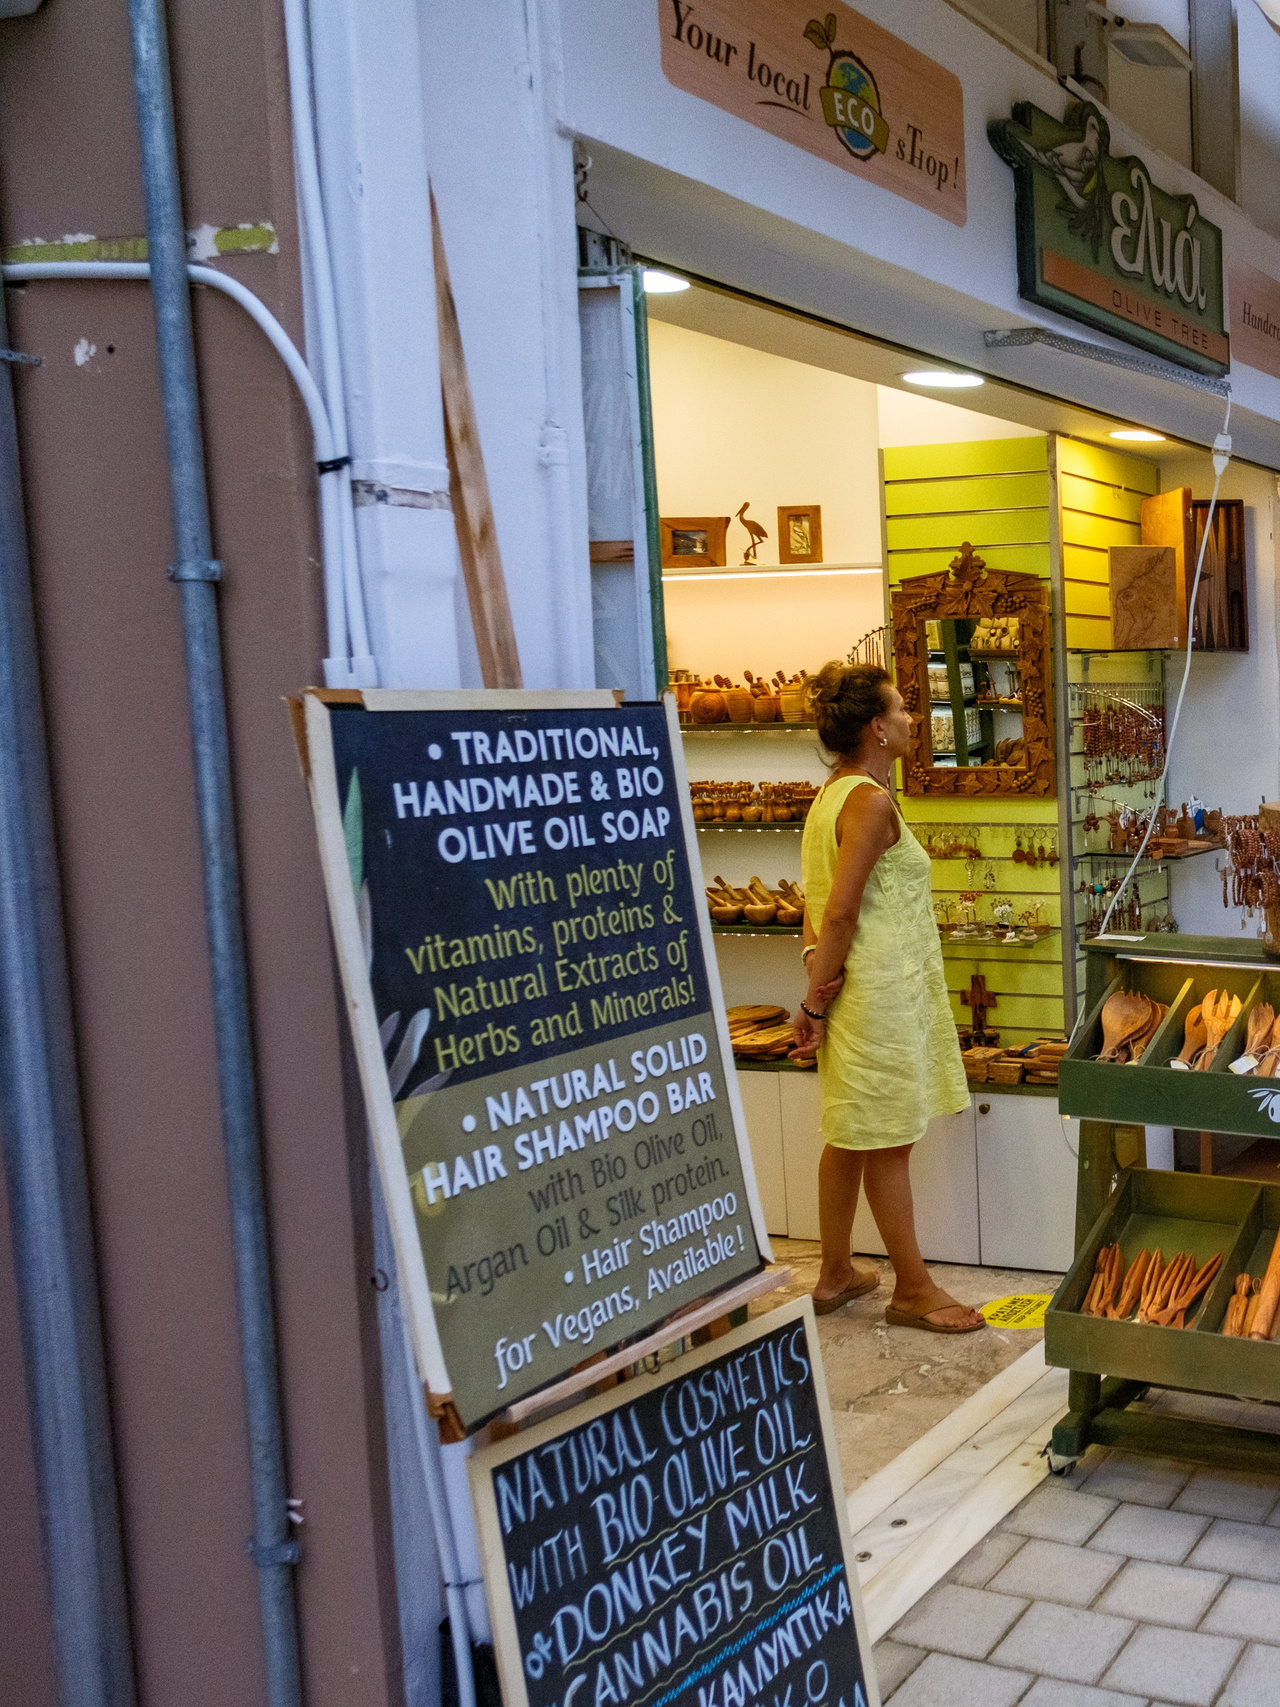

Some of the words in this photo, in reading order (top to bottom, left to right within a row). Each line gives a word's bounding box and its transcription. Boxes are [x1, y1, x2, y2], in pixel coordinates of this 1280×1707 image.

[670, 0, 738, 67] Your
[748, 41, 811, 110] local
[833, 92, 876, 136] ECO
[1111, 289, 1162, 328] OLIVE
[1171, 318, 1209, 350] TREE
[393, 770, 582, 819] HANDMADE
[589, 770, 611, 801] &
[616, 766, 664, 797] BIO
[450, 725, 660, 766] TRADITIONAL,
[437, 819, 537, 864] OLIVE
[543, 815, 596, 852] OIL
[603, 806, 671, 844] SOAP
[485, 876, 558, 911] With
[566, 857, 643, 904] plenty
[653, 849, 676, 891] of
[405, 922, 545, 976] vitamins,
[552, 900, 656, 958] proteins
[663, 894, 683, 925] &
[433, 965, 548, 1022] Natural
[555, 943, 660, 992] Extracts
[666, 930, 690, 971] of
[433, 1023, 520, 1074] Herbs
[530, 1009, 584, 1048] and
[590, 974, 697, 1030] Minerals!
[485, 1058, 627, 1133] NATURAL
[630, 1032, 709, 1084] SOLID
[422, 1143, 509, 1206] HAIR
[513, 1091, 660, 1172] SHAMPOO
[666, 1071, 717, 1115] BAR
[528, 1169, 583, 1215] with
[590, 1153, 626, 1190] Bio
[634, 1129, 686, 1172] Olive
[690, 1112, 724, 1146] Oil,
[445, 1240, 529, 1302] Argan
[536, 1217, 571, 1258] Oil
[578, 1208, 600, 1241] &
[605, 1188, 643, 1229] Silk
[651, 1154, 730, 1218] protein.
[581, 1235, 633, 1286] Hair
[638, 1190, 738, 1257] Shampoo
[493, 1334, 537, 1391] for
[541, 1289, 641, 1350] Vegans,
[496, 1405, 660, 1534] NATURAL
[661, 1326, 810, 1447] COSMETICS
[508, 1525, 589, 1611] WITH
[591, 1473, 653, 1564] BIO
[662, 1422, 750, 1519] OLIVE
[755, 1398, 812, 1466] OIL
[550, 1513, 710, 1666] DONKEY
[725, 1460, 818, 1551] MILK
[762, 1525, 824, 1593] OIL
